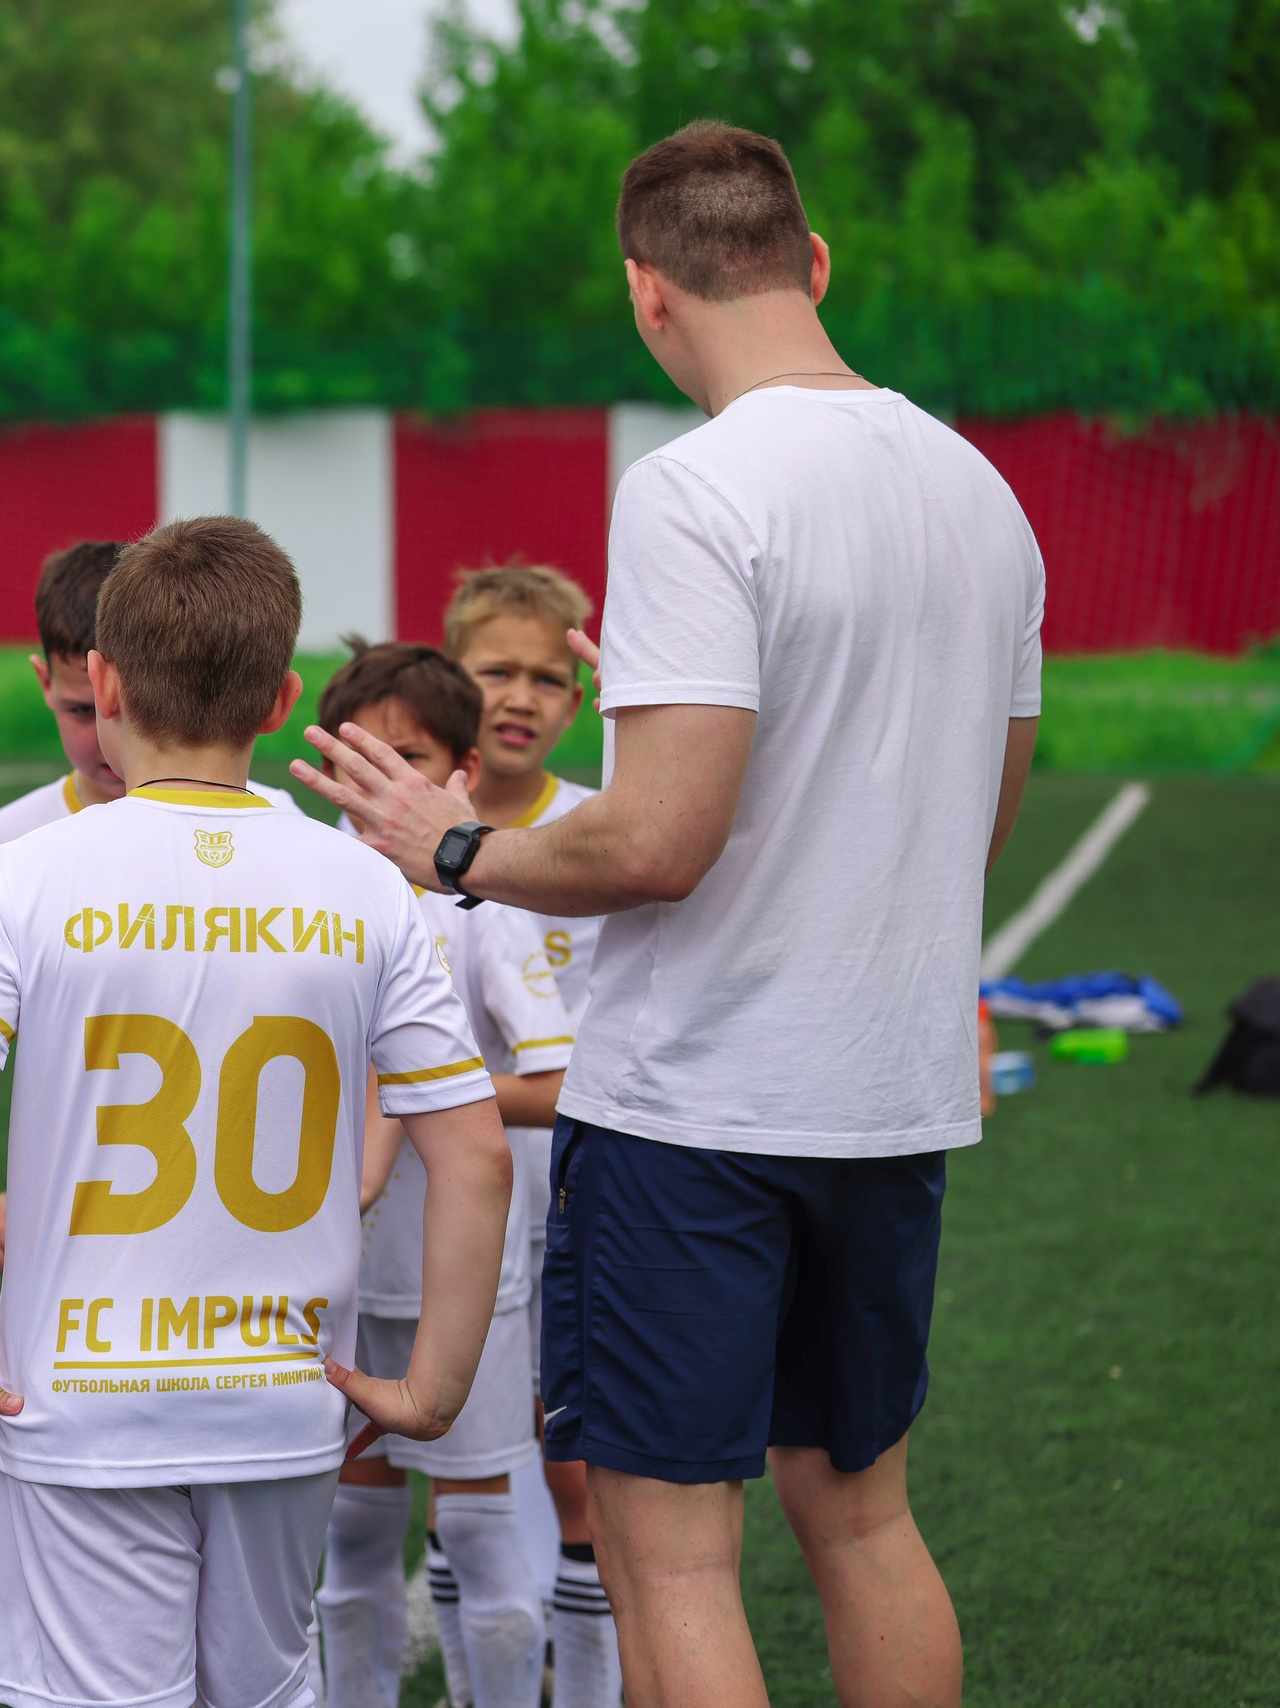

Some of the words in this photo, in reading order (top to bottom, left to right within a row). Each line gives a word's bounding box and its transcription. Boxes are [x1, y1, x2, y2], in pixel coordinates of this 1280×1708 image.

[63, 903, 365, 965] ФИЛЯКИН
[69, 1014, 341, 1236] 30
[56, 1298, 114, 1352] FC
[140, 1296, 329, 1352] IMPULS
[51, 1378, 150, 1393] ФУТБОЛЬНАЯ
[156, 1376, 210, 1392] ШКОЛА
[215, 1373, 267, 1390] СЕРГЕЯ
[272, 1366, 323, 1387] НИКИТИНА
